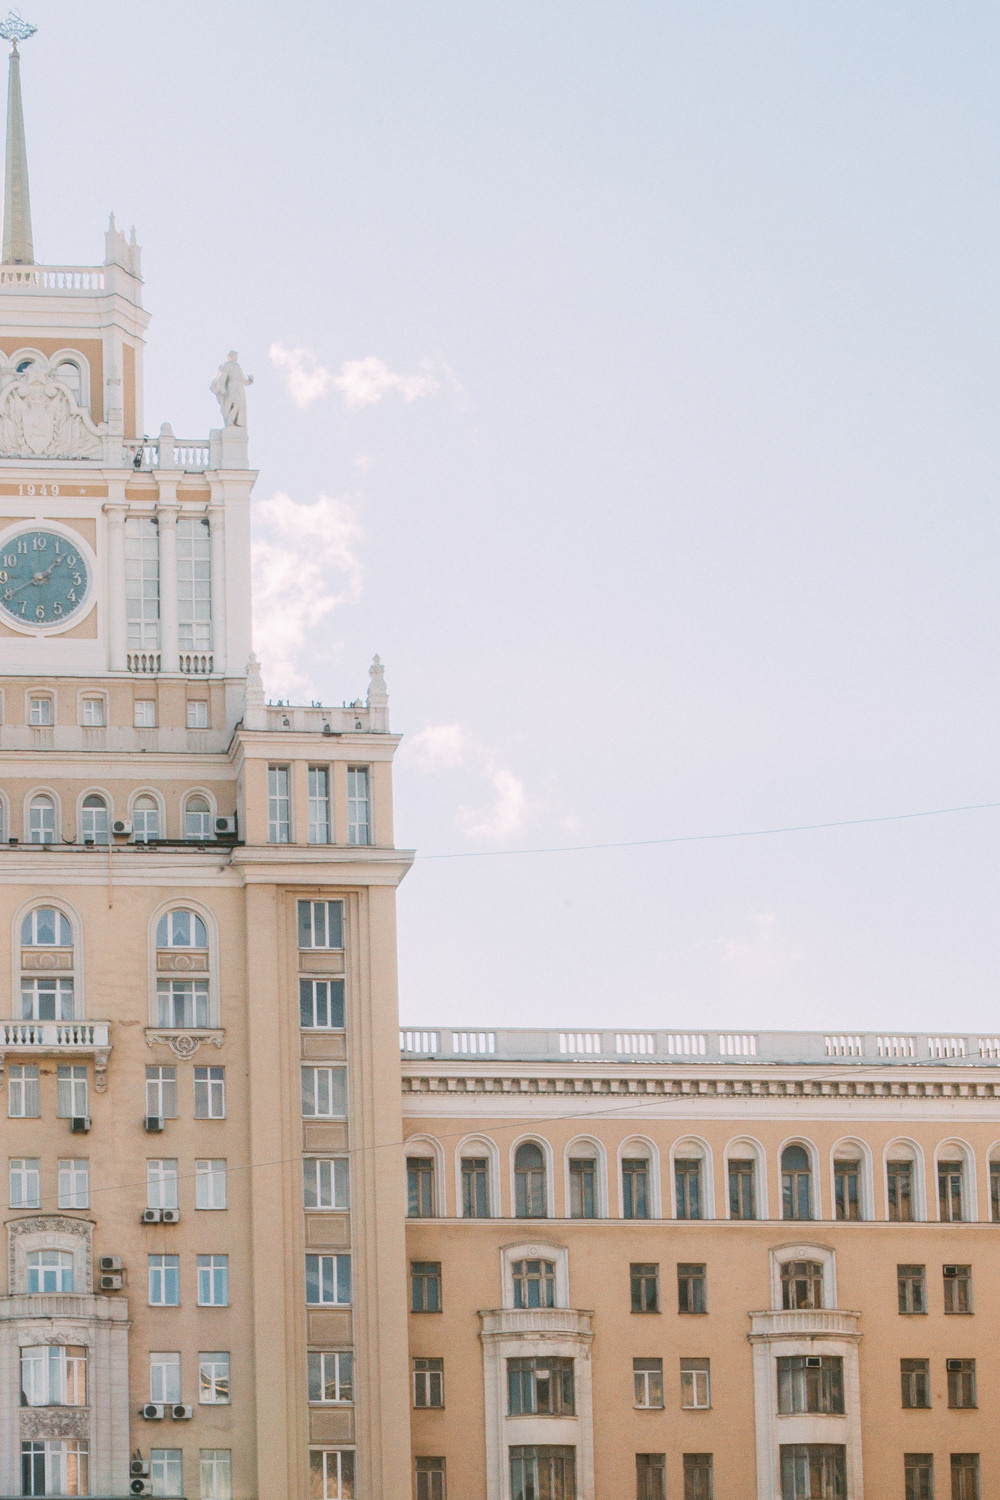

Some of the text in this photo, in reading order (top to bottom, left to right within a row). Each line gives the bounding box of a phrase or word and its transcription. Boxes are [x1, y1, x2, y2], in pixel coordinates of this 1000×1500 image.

[19, 484, 59, 496] 1949
[16, 540, 27, 554] 11
[32, 537, 46, 551] 12
[54, 541, 60, 554] 1
[3, 554, 16, 567] 10
[72, 572, 81, 585] 3
[67, 588, 76, 601] 4
[18, 600, 27, 614] 7
[36, 605, 44, 618] 6
[53, 602, 62, 614] 5
